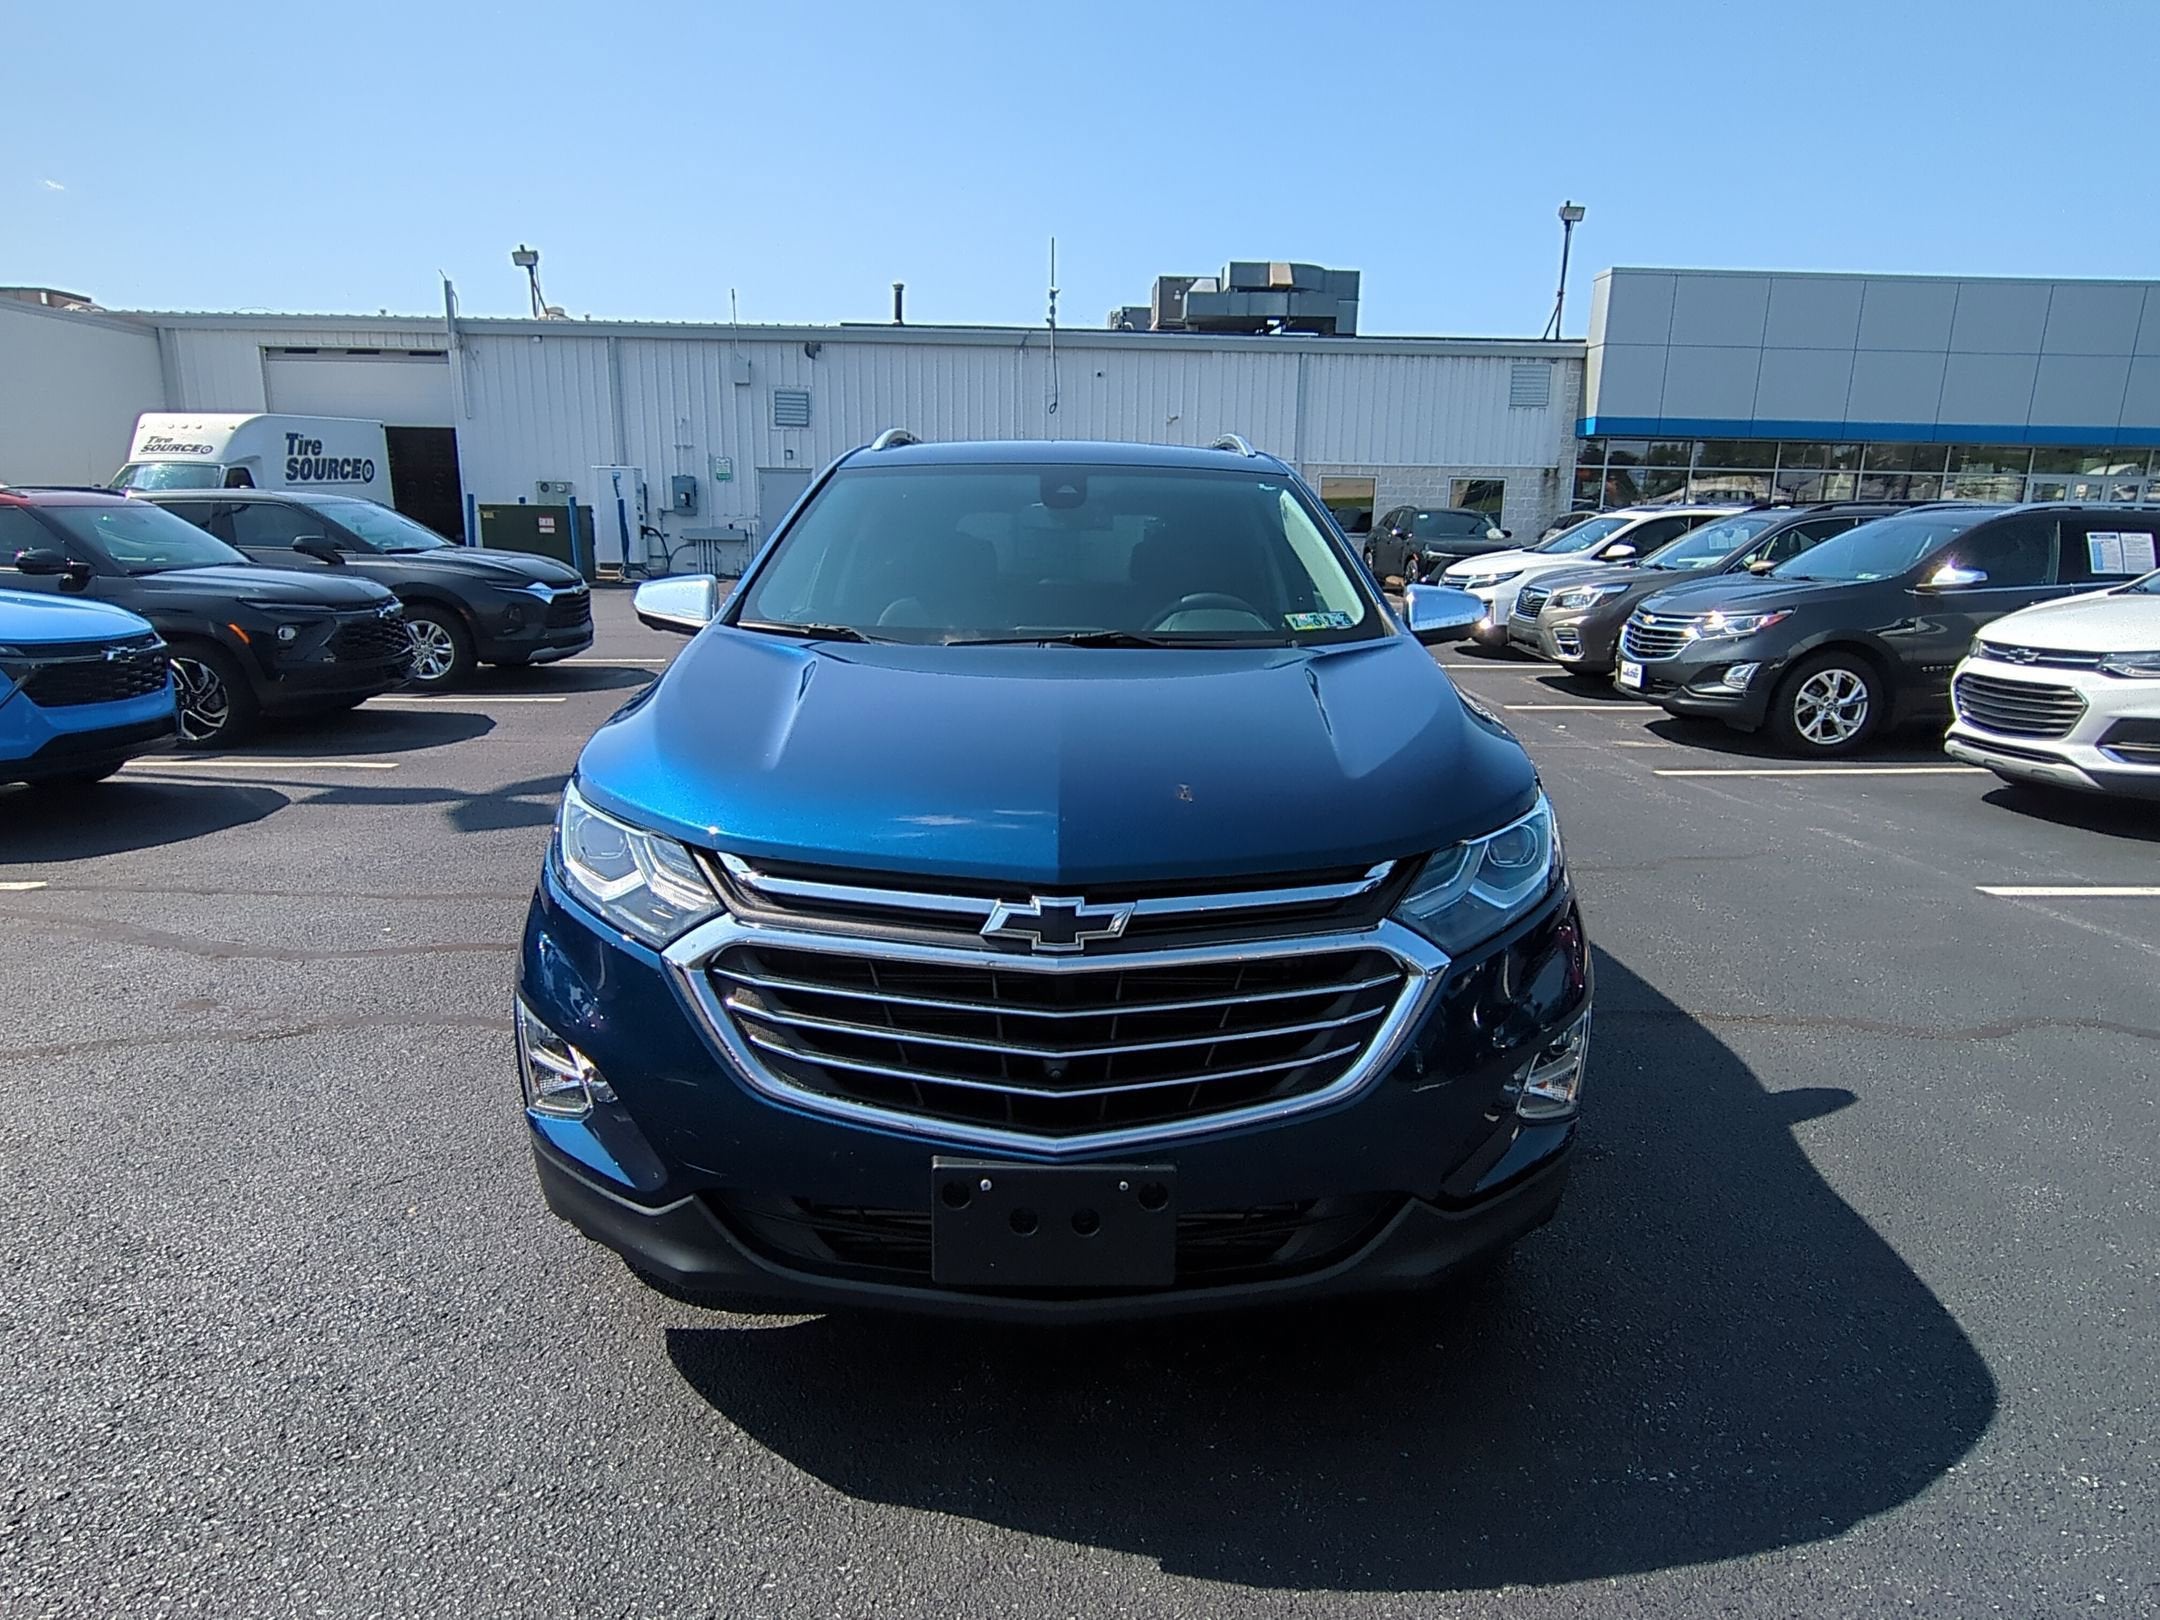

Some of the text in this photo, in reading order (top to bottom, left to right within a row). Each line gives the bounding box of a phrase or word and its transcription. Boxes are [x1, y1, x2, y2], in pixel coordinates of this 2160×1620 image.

[140, 443, 203, 453] SOURCE
[147, 435, 174, 444] Tire
[285, 432, 322, 456] Tire
[285, 457, 362, 481] SOURCE
